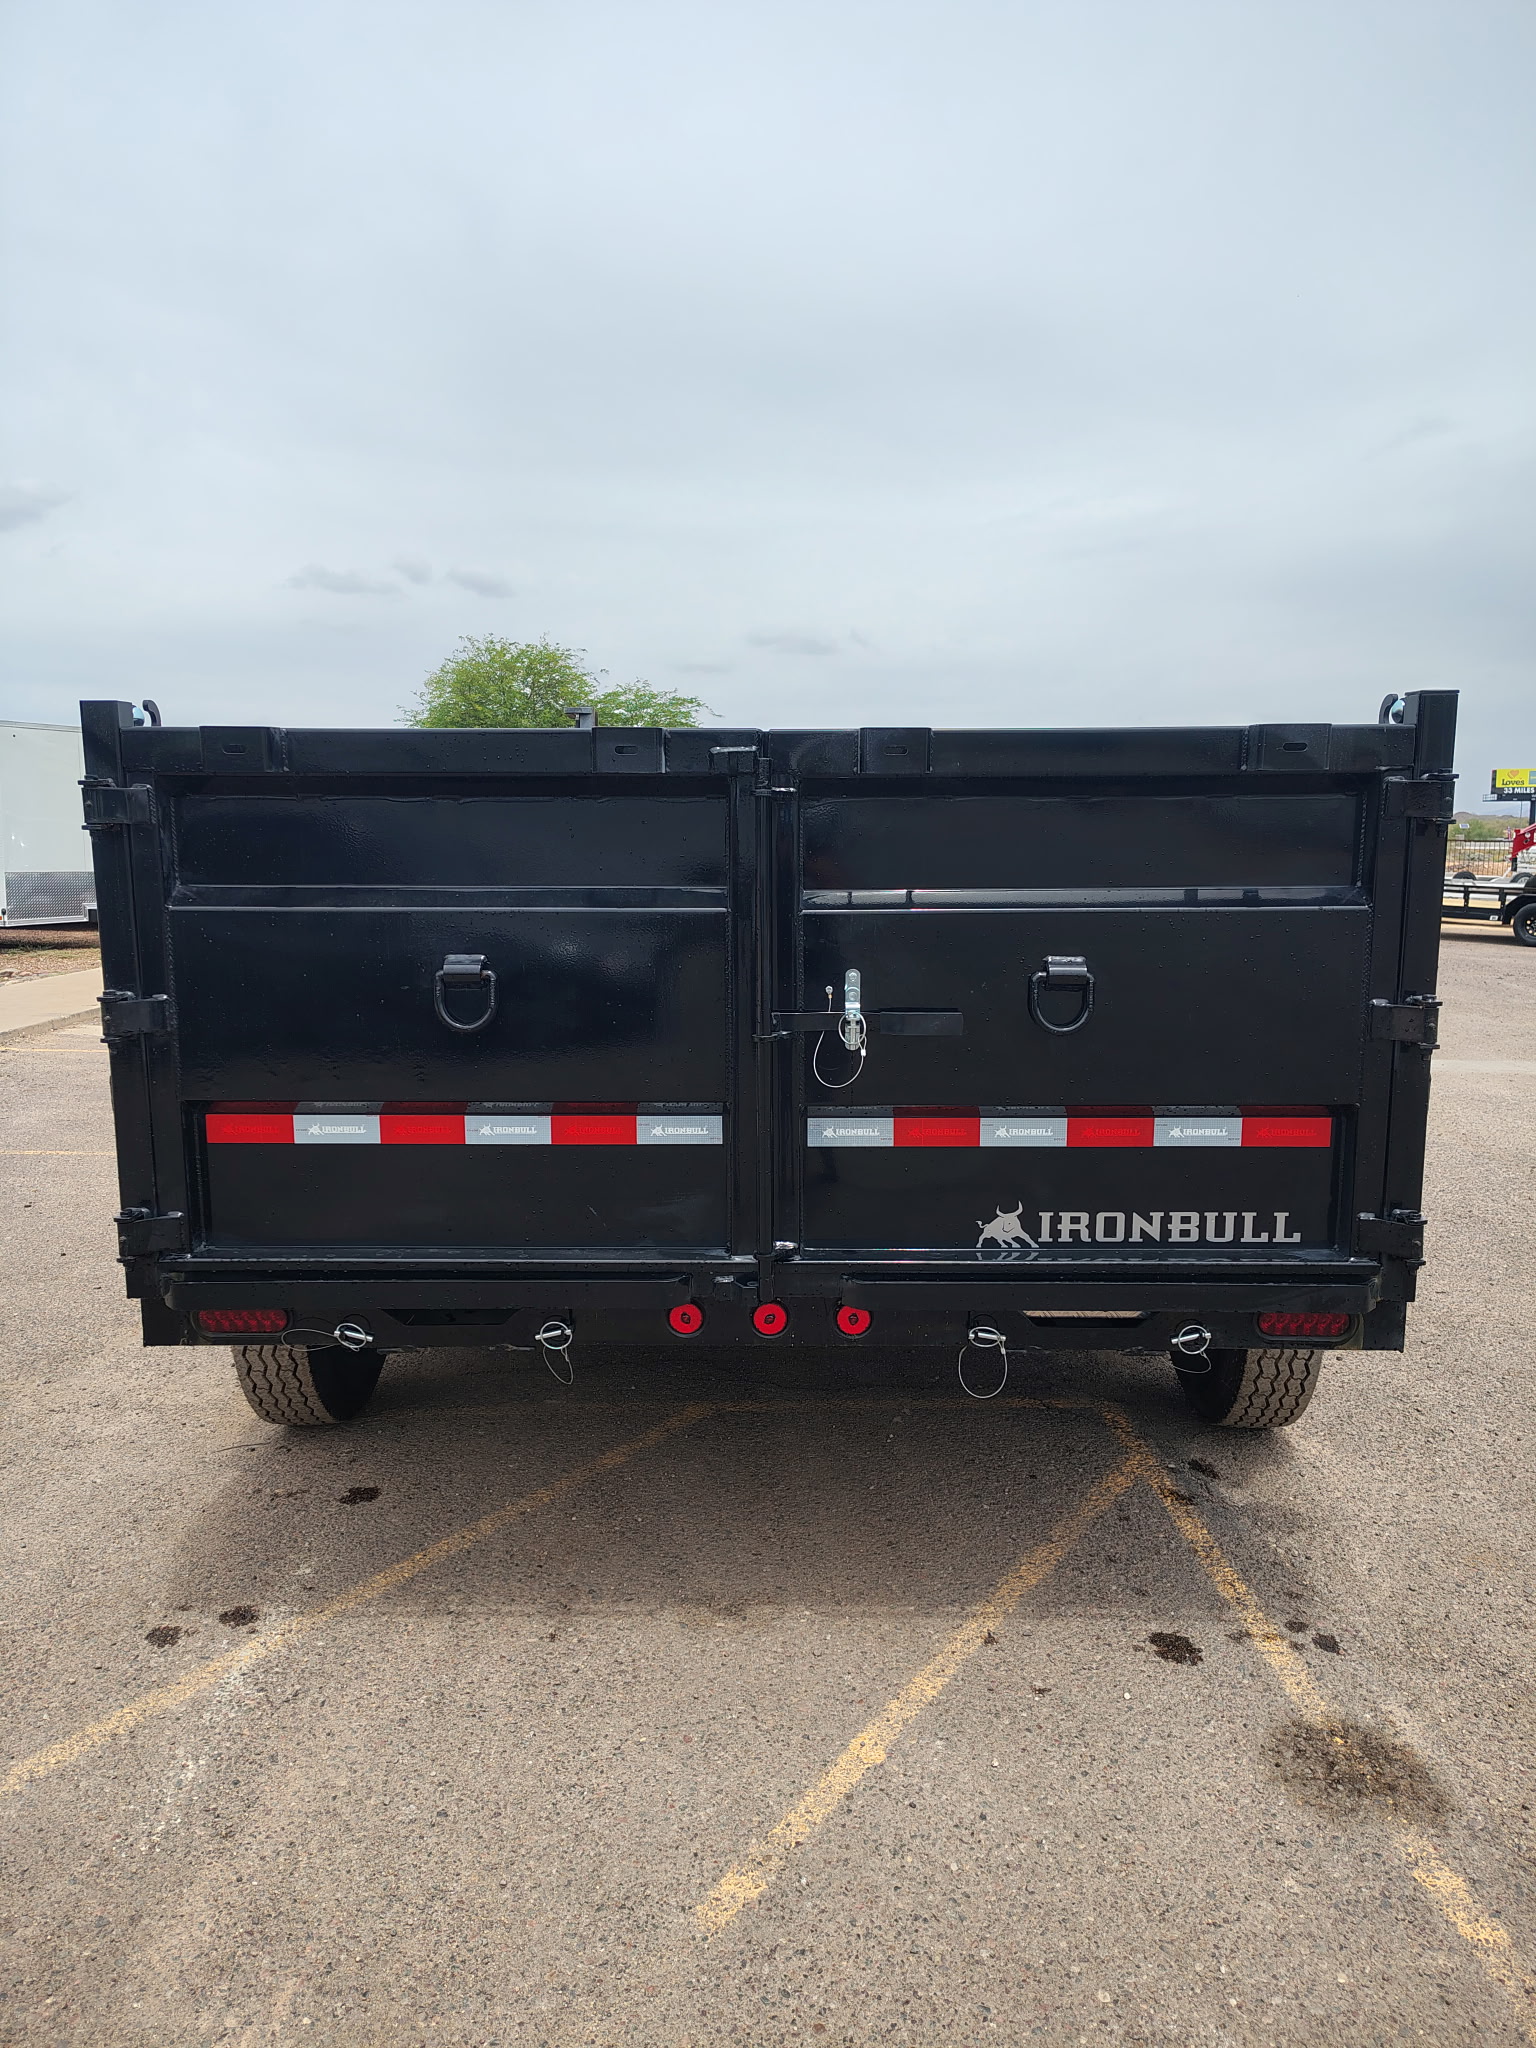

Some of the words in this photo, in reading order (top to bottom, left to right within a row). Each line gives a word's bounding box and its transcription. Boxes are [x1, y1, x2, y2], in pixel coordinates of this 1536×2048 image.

[322, 1125, 367, 1134] IRONBULL
[493, 1125, 537, 1134] IRONBULL
[665, 1126, 708, 1135] IRONBULL
[836, 1127, 880, 1136] IRONBULL
[1009, 1127, 1053, 1136] IRONBULL
[1183, 1127, 1228, 1136] IRONBULL
[1038, 1212, 1301, 1243] IRONBULL
